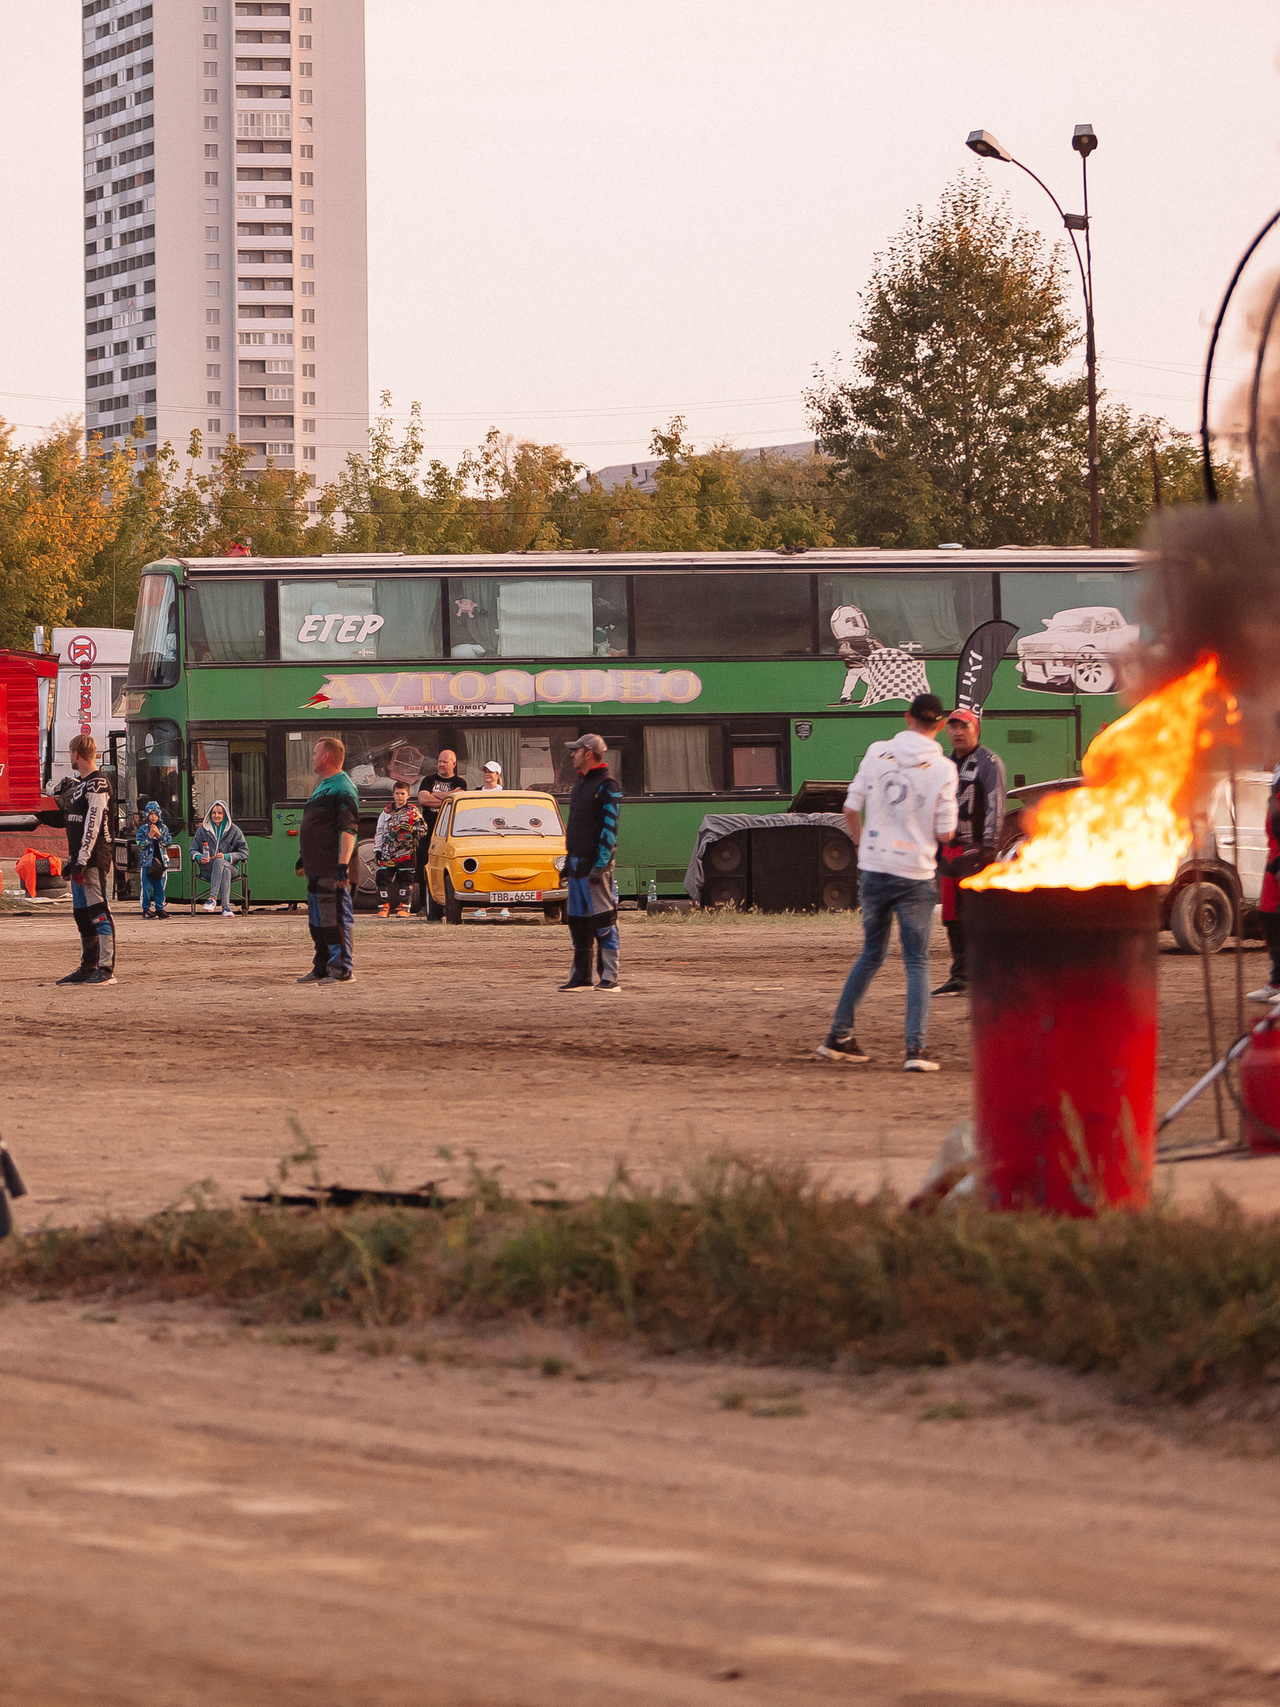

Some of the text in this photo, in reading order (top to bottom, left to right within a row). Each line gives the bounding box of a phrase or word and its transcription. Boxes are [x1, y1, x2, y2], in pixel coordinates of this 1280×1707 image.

[73, 642, 92, 736] Каскаде
[324, 671, 696, 705] AVTORODEO
[82, 806, 98, 850] Supreme
